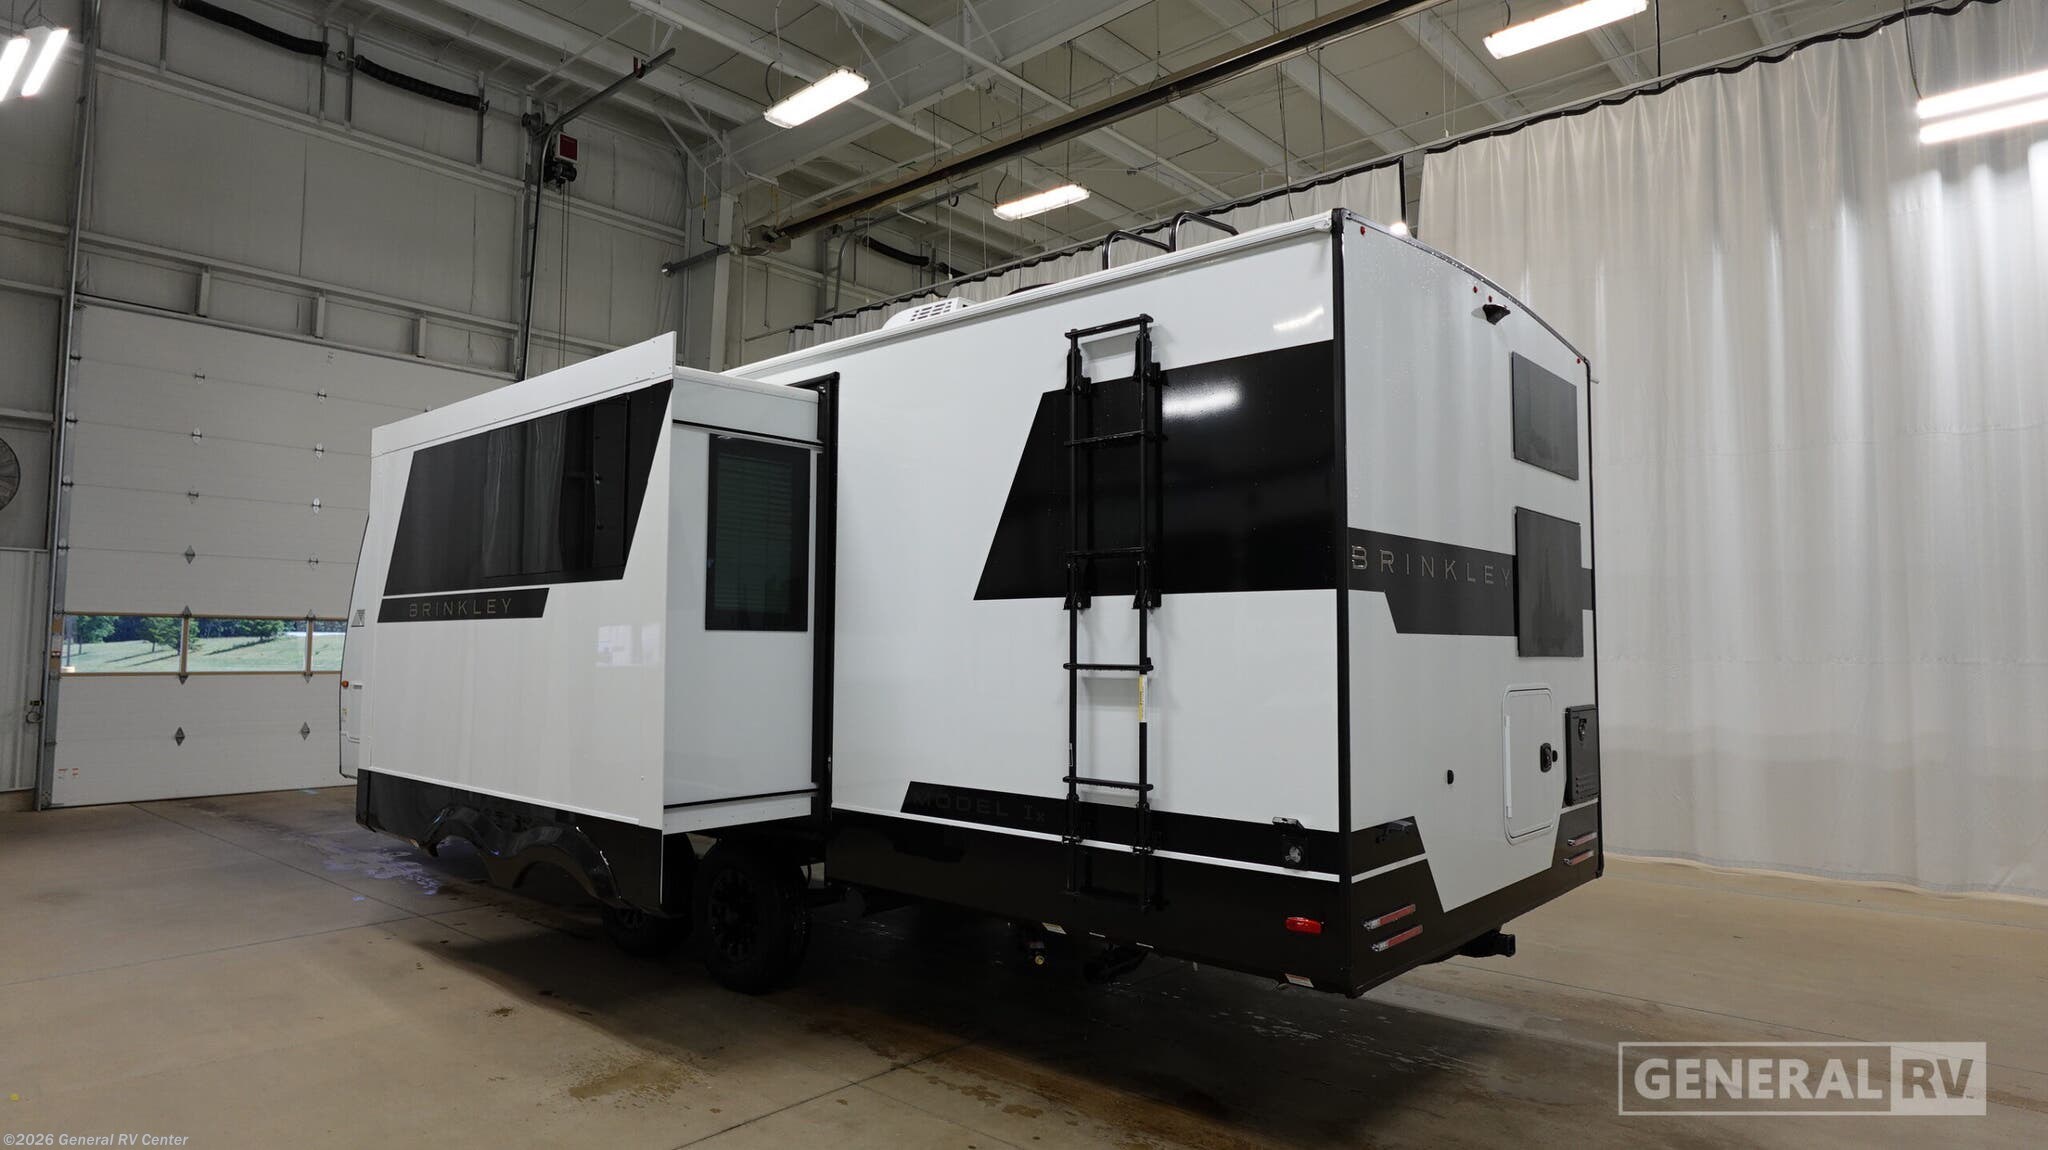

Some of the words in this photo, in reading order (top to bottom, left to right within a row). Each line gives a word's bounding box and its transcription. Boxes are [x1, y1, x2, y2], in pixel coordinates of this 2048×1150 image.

[1351, 545, 1512, 586] BRINKLEY
[408, 598, 512, 617] BRINKLEY
[913, 790, 1009, 817] MODEL
